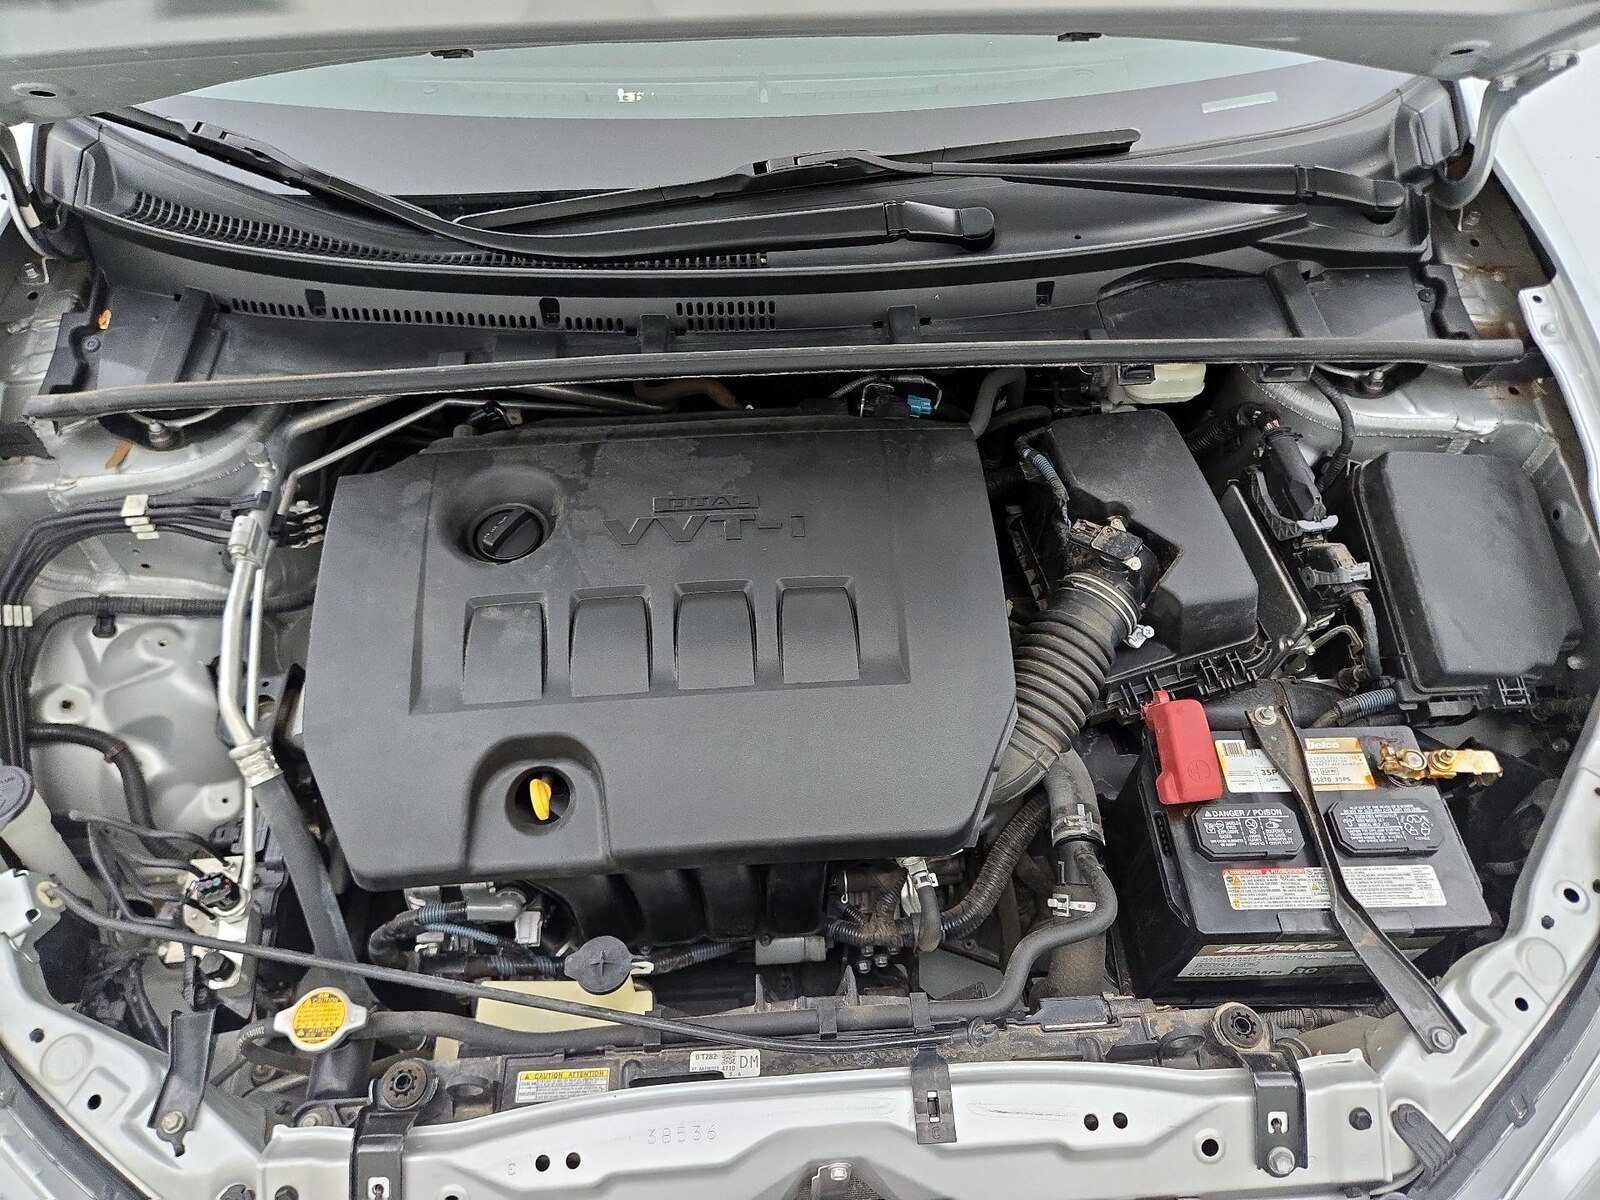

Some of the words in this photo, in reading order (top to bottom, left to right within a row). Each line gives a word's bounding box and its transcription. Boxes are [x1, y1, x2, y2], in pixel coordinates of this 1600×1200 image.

[668, 496, 750, 507] DUAL
[1304, 741, 1340, 750] Delco
[1261, 769, 1279, 777] 35P
[1212, 809, 1246, 817] DANGER
[1252, 808, 1283, 816] POISON
[1216, 943, 1339, 953] ACDelco
[740, 1055, 759, 1069] DM
[534, 1072, 564, 1080] CAUTION
[568, 1070, 605, 1079] ATTENTION
[647, 1124, 718, 1145] 38536
